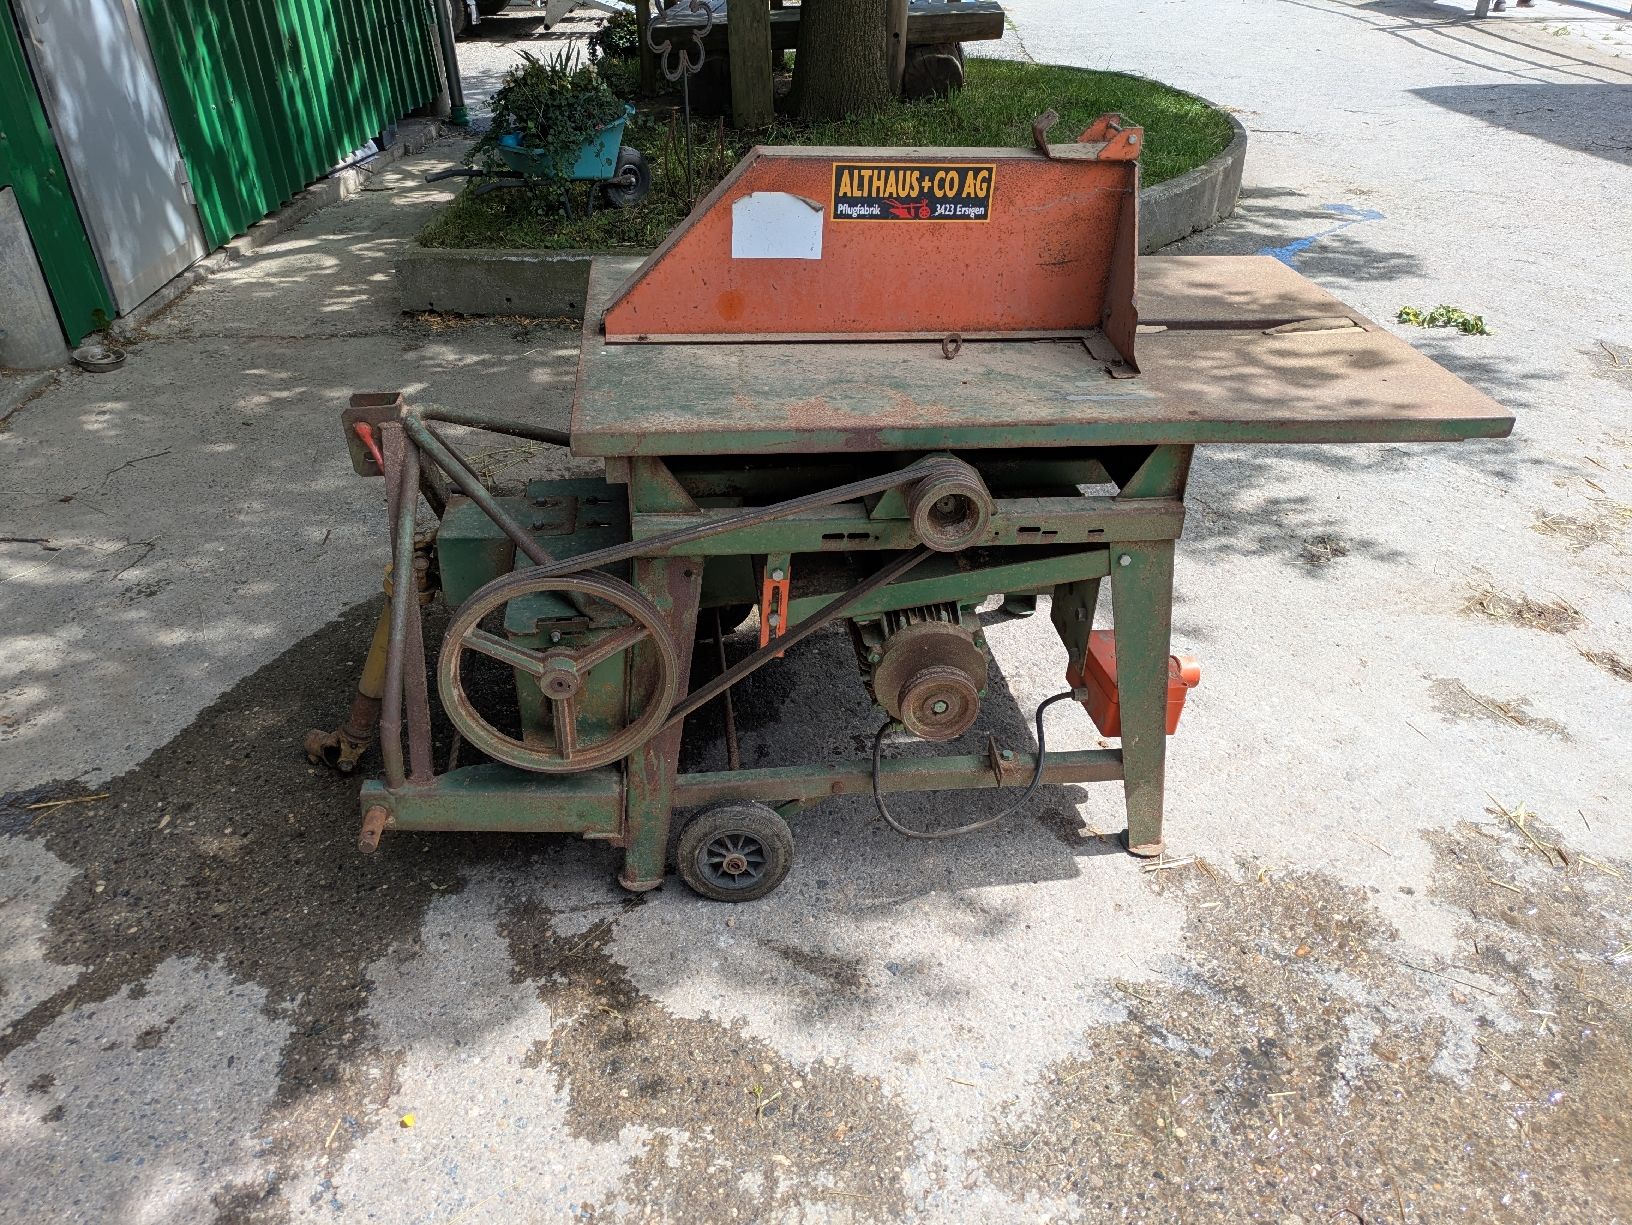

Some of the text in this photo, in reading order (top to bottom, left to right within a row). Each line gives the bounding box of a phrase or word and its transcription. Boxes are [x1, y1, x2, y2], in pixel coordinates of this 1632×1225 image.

[962, 170, 989, 198] AG
[837, 203, 881, 217] Pflugfabrik
[935, 204, 985, 217] 3423 Ersigen
